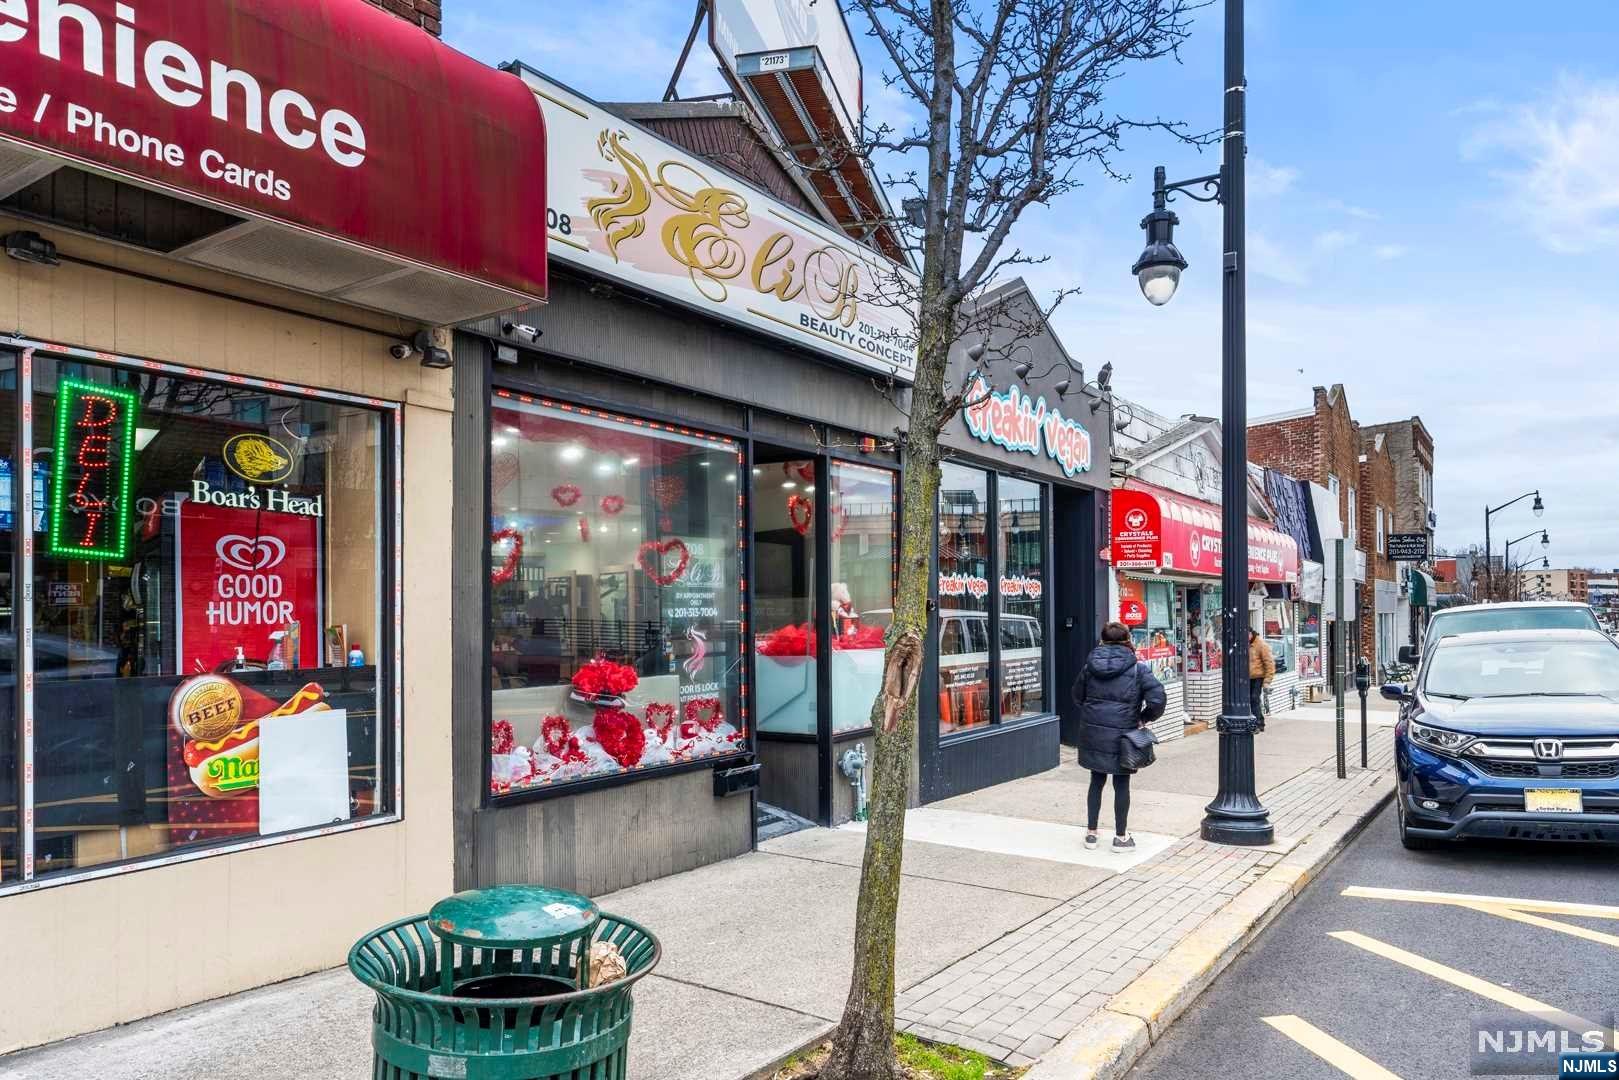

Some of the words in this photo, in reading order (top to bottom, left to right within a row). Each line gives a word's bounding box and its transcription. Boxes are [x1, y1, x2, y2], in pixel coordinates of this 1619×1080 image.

[67, 102, 184, 168] Phone
[199, 148, 291, 201] Cards
[800, 313, 855, 345] BEAUTY
[858, 337, 913, 368] CONCEPT
[76, 394, 117, 546] DELI
[192, 479, 261, 511] Boar's
[266, 482, 323, 517] Head
[218, 574, 283, 599] GOOD
[206, 600, 298, 625] HUMOR
[674, 607, 718, 618] 201-313-7004
[702, 682, 719, 691] LOCK
[187, 697, 236, 726] BEEF
